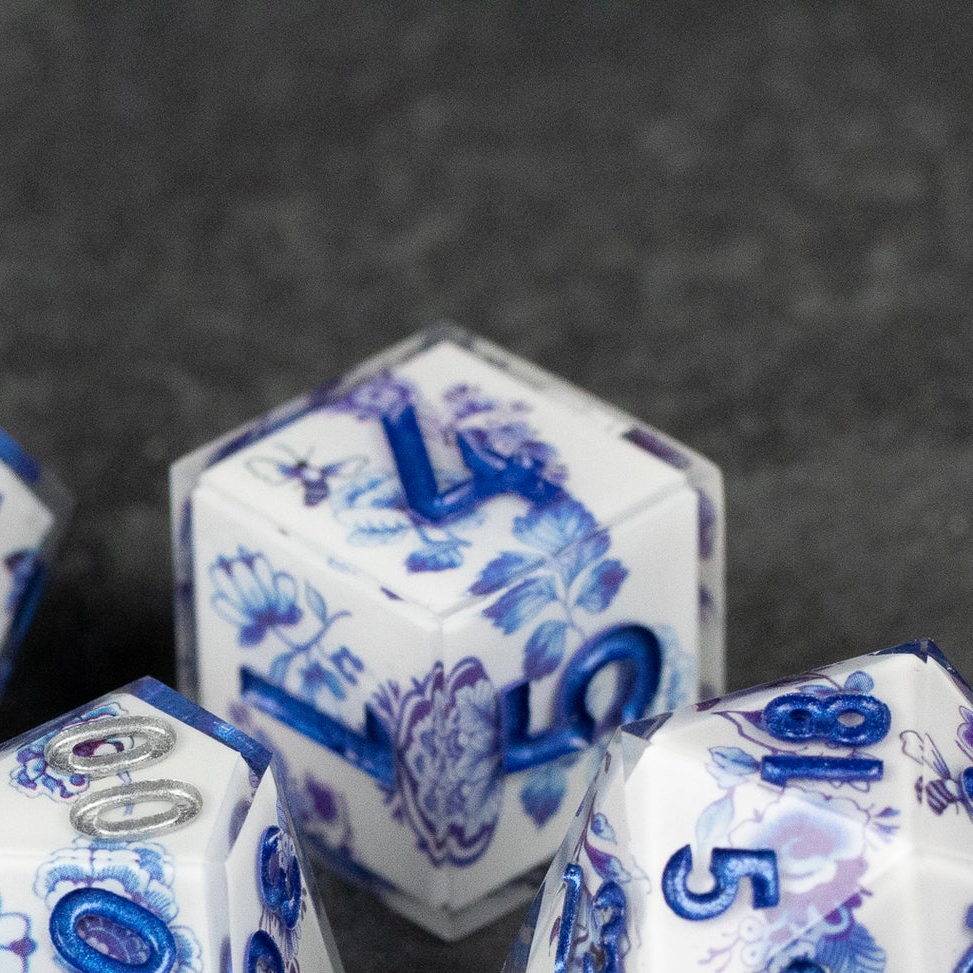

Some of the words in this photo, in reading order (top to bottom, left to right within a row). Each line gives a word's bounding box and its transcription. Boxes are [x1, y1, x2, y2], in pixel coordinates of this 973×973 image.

[45, 714, 203, 839] 00
[760, 693, 891, 784] 18
[662, 845, 779, 922] 5
